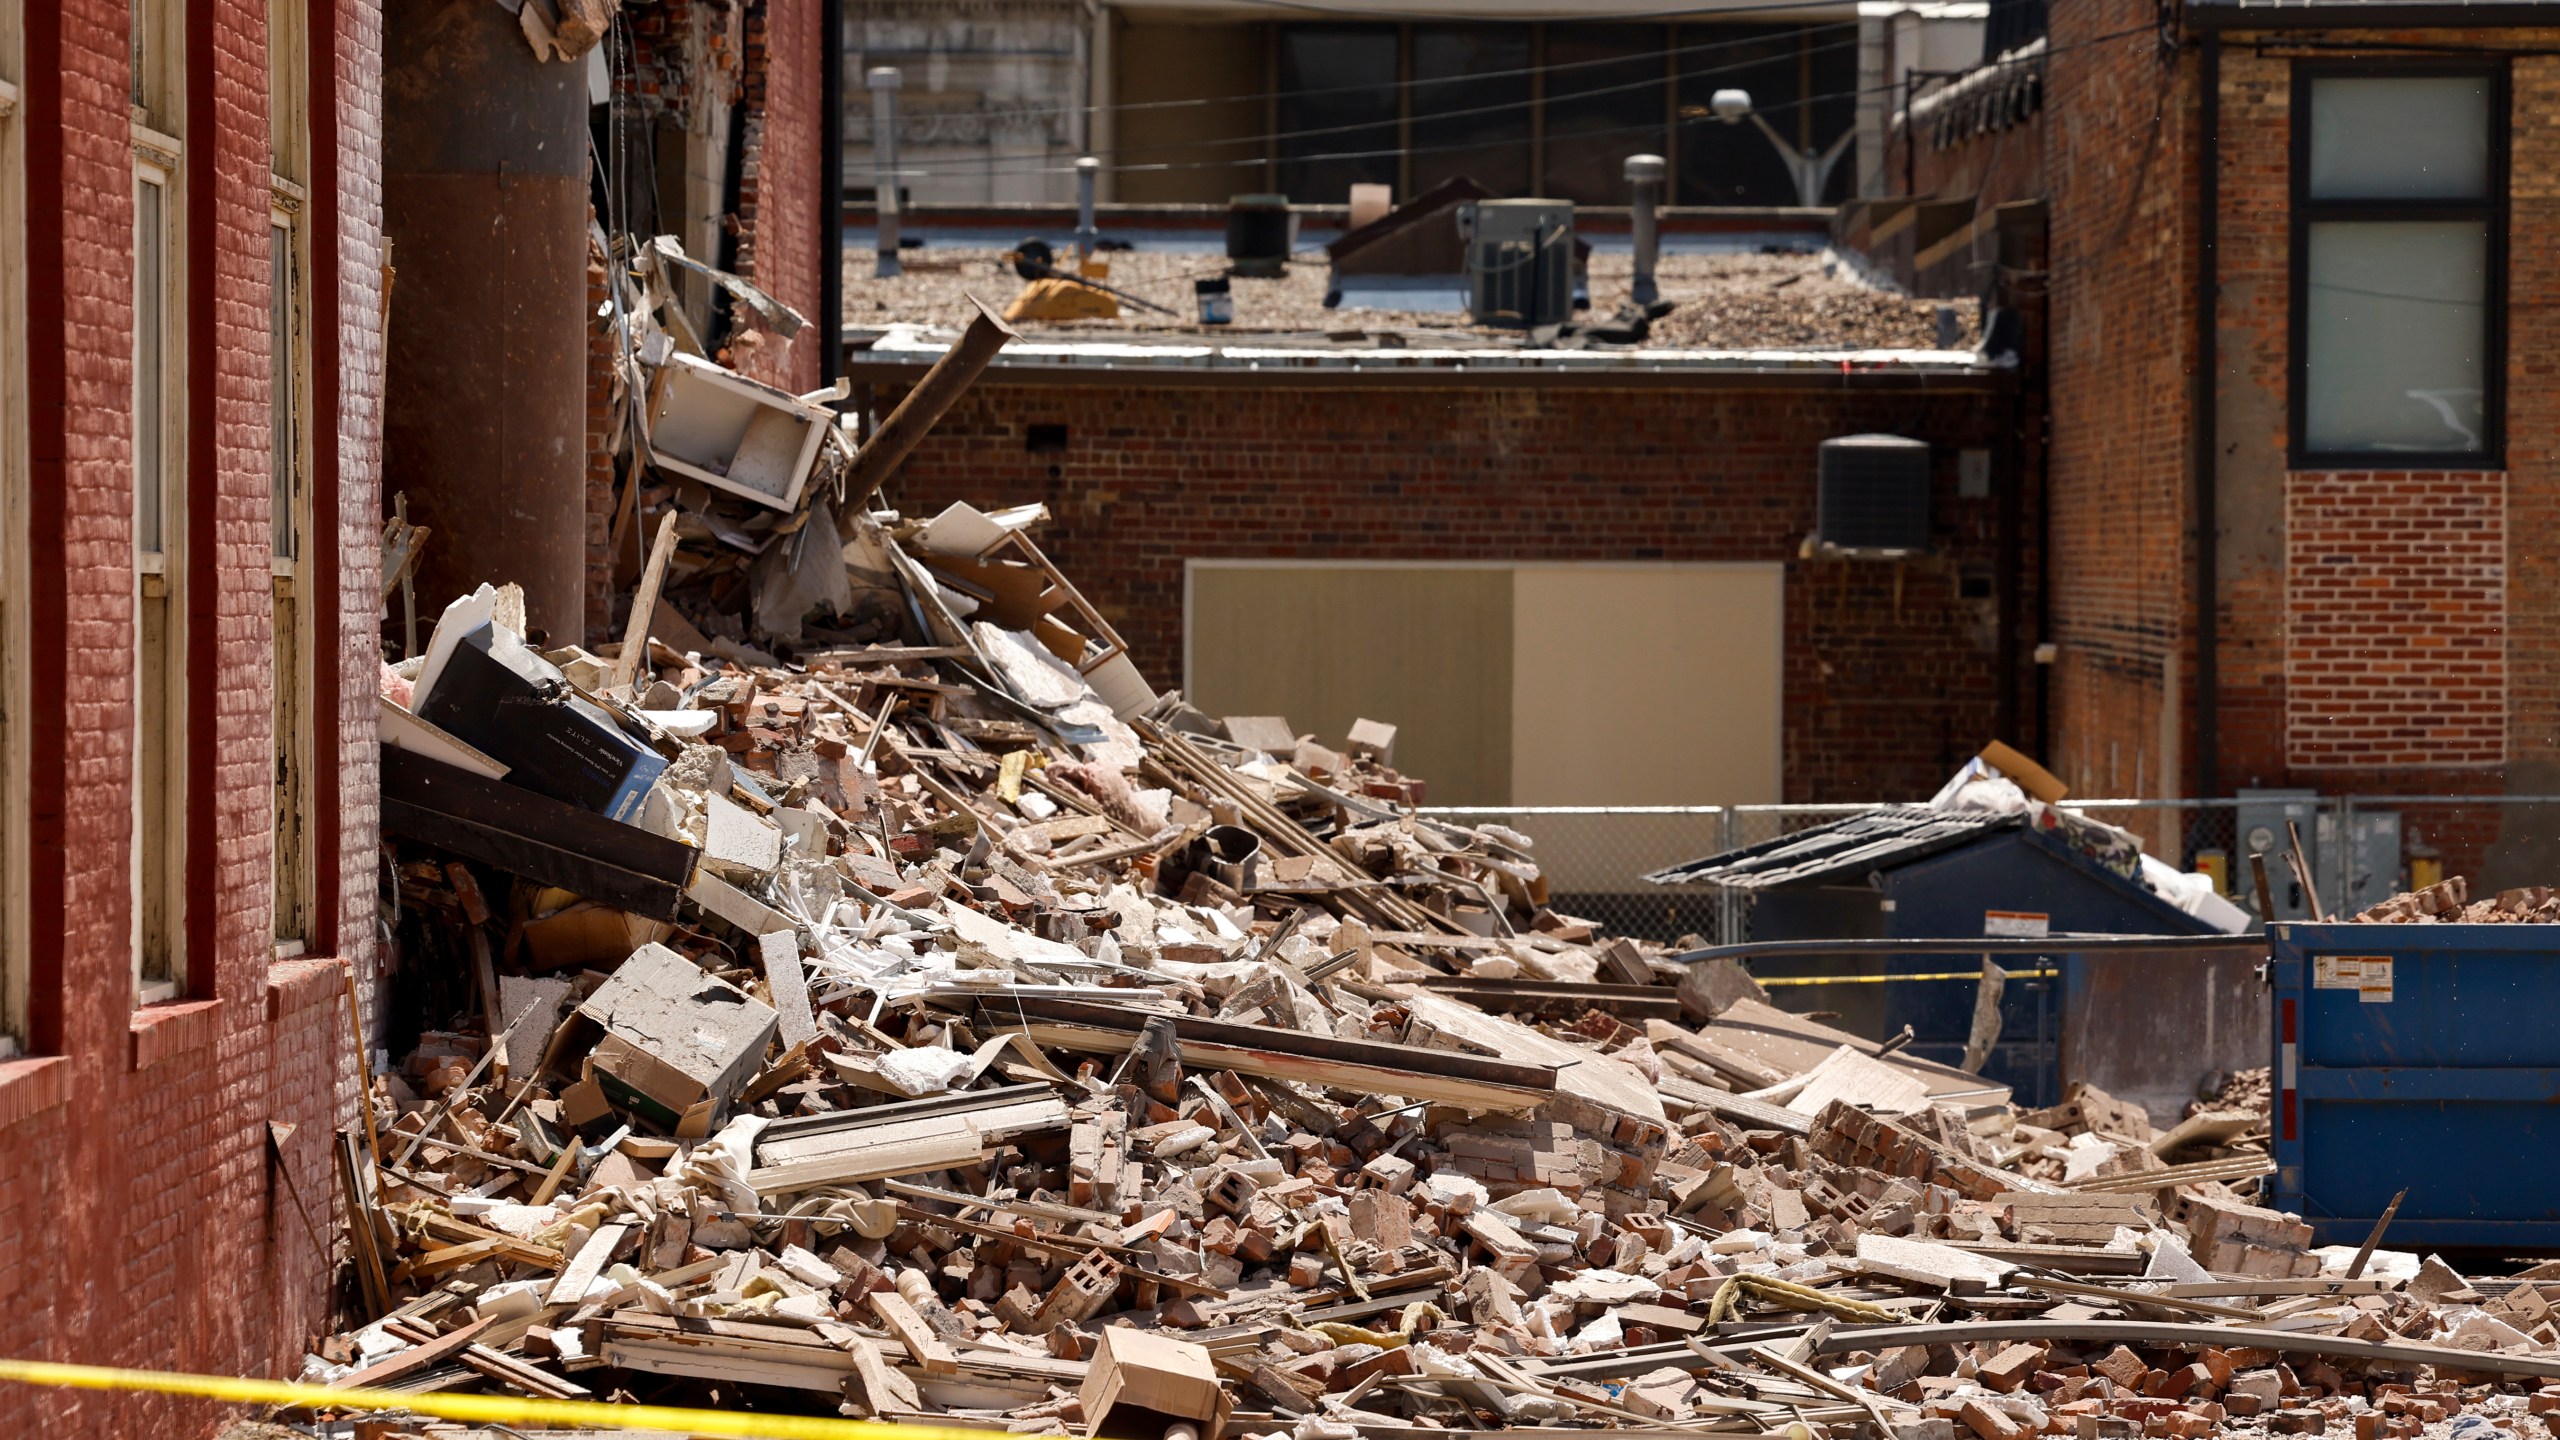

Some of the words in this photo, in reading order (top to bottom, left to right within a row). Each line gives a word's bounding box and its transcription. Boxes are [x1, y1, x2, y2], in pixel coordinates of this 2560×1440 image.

[559, 739, 575, 753] Gaming
[573, 749, 585, 759] Color
[596, 746, 624, 767] ViewSonic
